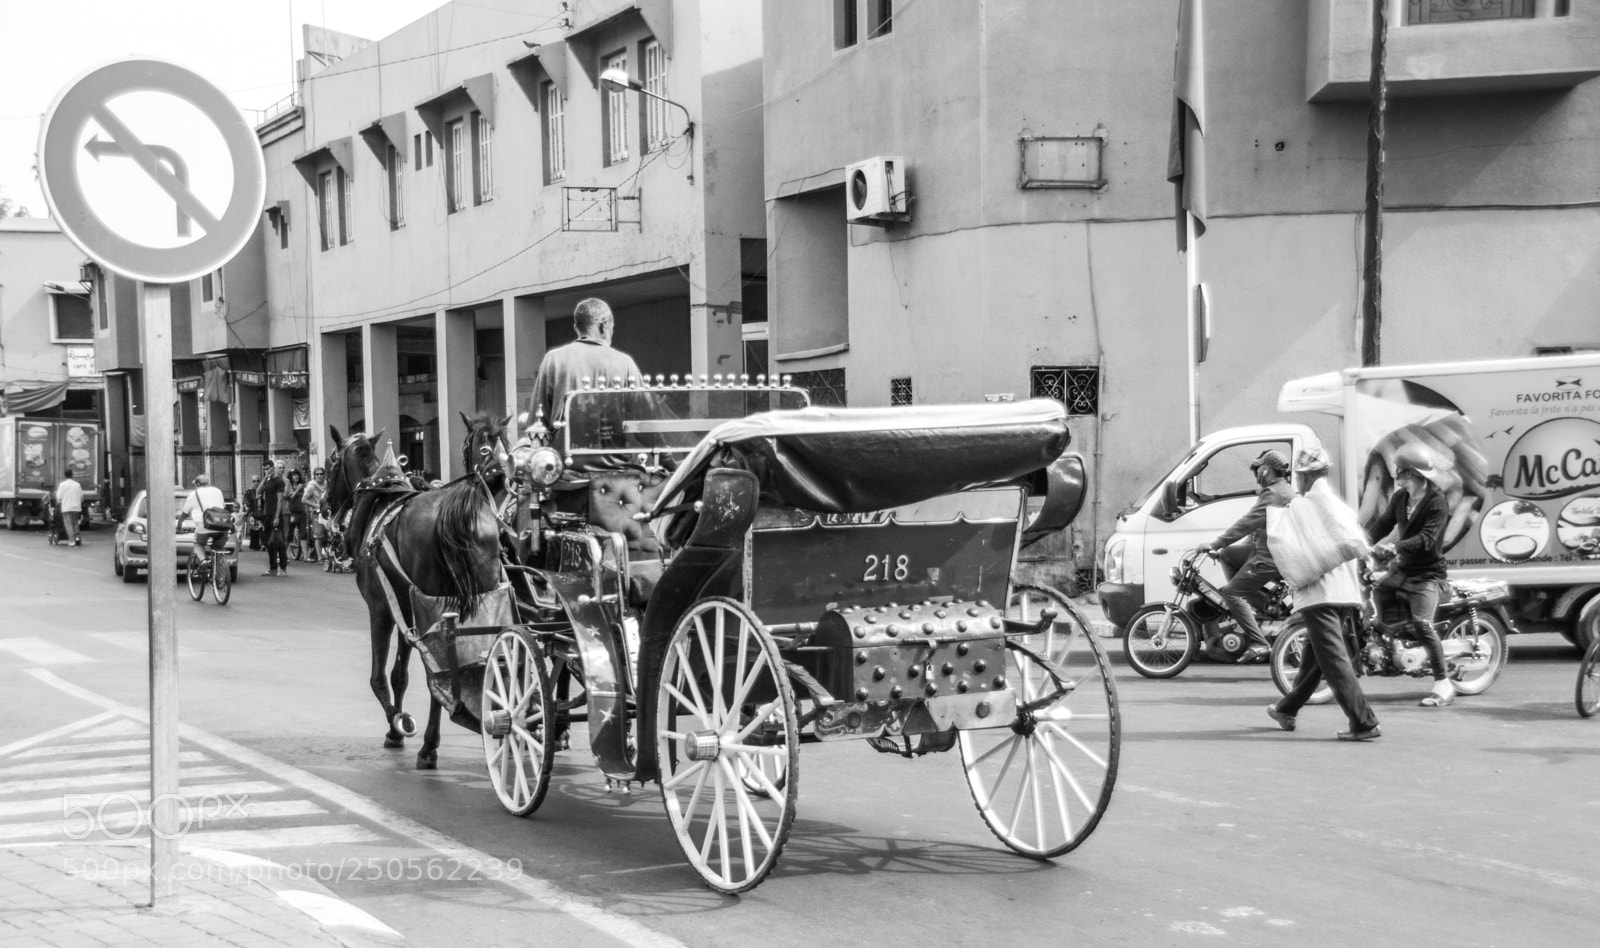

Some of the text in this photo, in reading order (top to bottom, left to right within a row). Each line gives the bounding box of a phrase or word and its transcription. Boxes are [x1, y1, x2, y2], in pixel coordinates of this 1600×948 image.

[1516, 391, 1582, 403] FAVORITA
[1488, 407, 1528, 418] Favorita
[563, 541, 582, 568] 218
[863, 554, 909, 581] 218
[1441, 557, 1458, 565] our
[1460, 557, 1487, 567] passer
